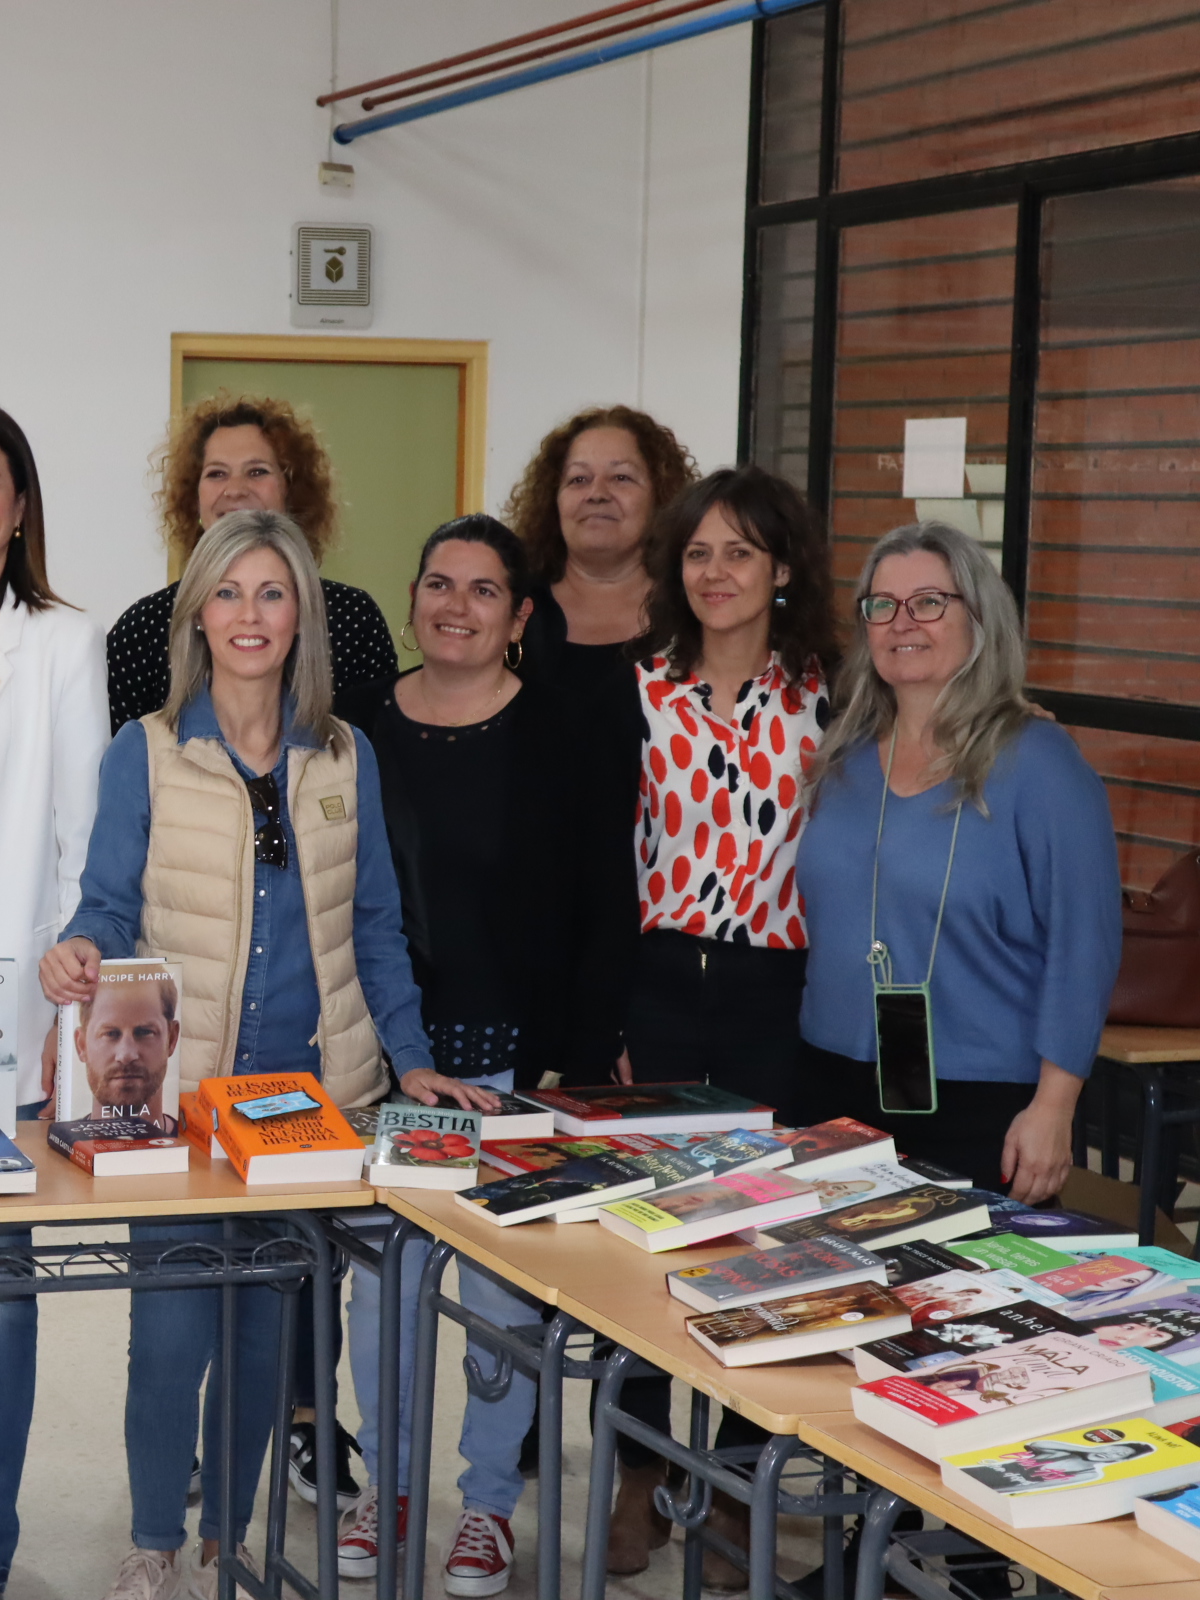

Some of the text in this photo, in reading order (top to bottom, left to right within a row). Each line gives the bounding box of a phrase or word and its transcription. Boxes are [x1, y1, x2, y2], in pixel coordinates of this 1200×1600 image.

[98, 972, 175, 983] NCIPE HARRY
[226, 1080, 299, 1091] ELÍSABET
[226, 1086, 306, 1097] BENAVENT
[101, 1104, 150, 1118] EN LA
[70, 1124, 147, 1132] CASTILLO
[384, 1111, 476, 1132] BESTIA
[259, 1127, 334, 1137] NUESTRA
[263, 1134, 339, 1145] HISTORIA
[910, 1187, 966, 1206] ECOS
[817, 1236, 846, 1250] SARAH
[849, 1252, 876, 1266] MAAS
[750, 1254, 803, 1278] ROSAS
[1000, 1308, 1056, 1333] anhel
[1018, 1344, 1089, 1375] MALA
[1089, 1350, 1125, 1368] CRIADO
